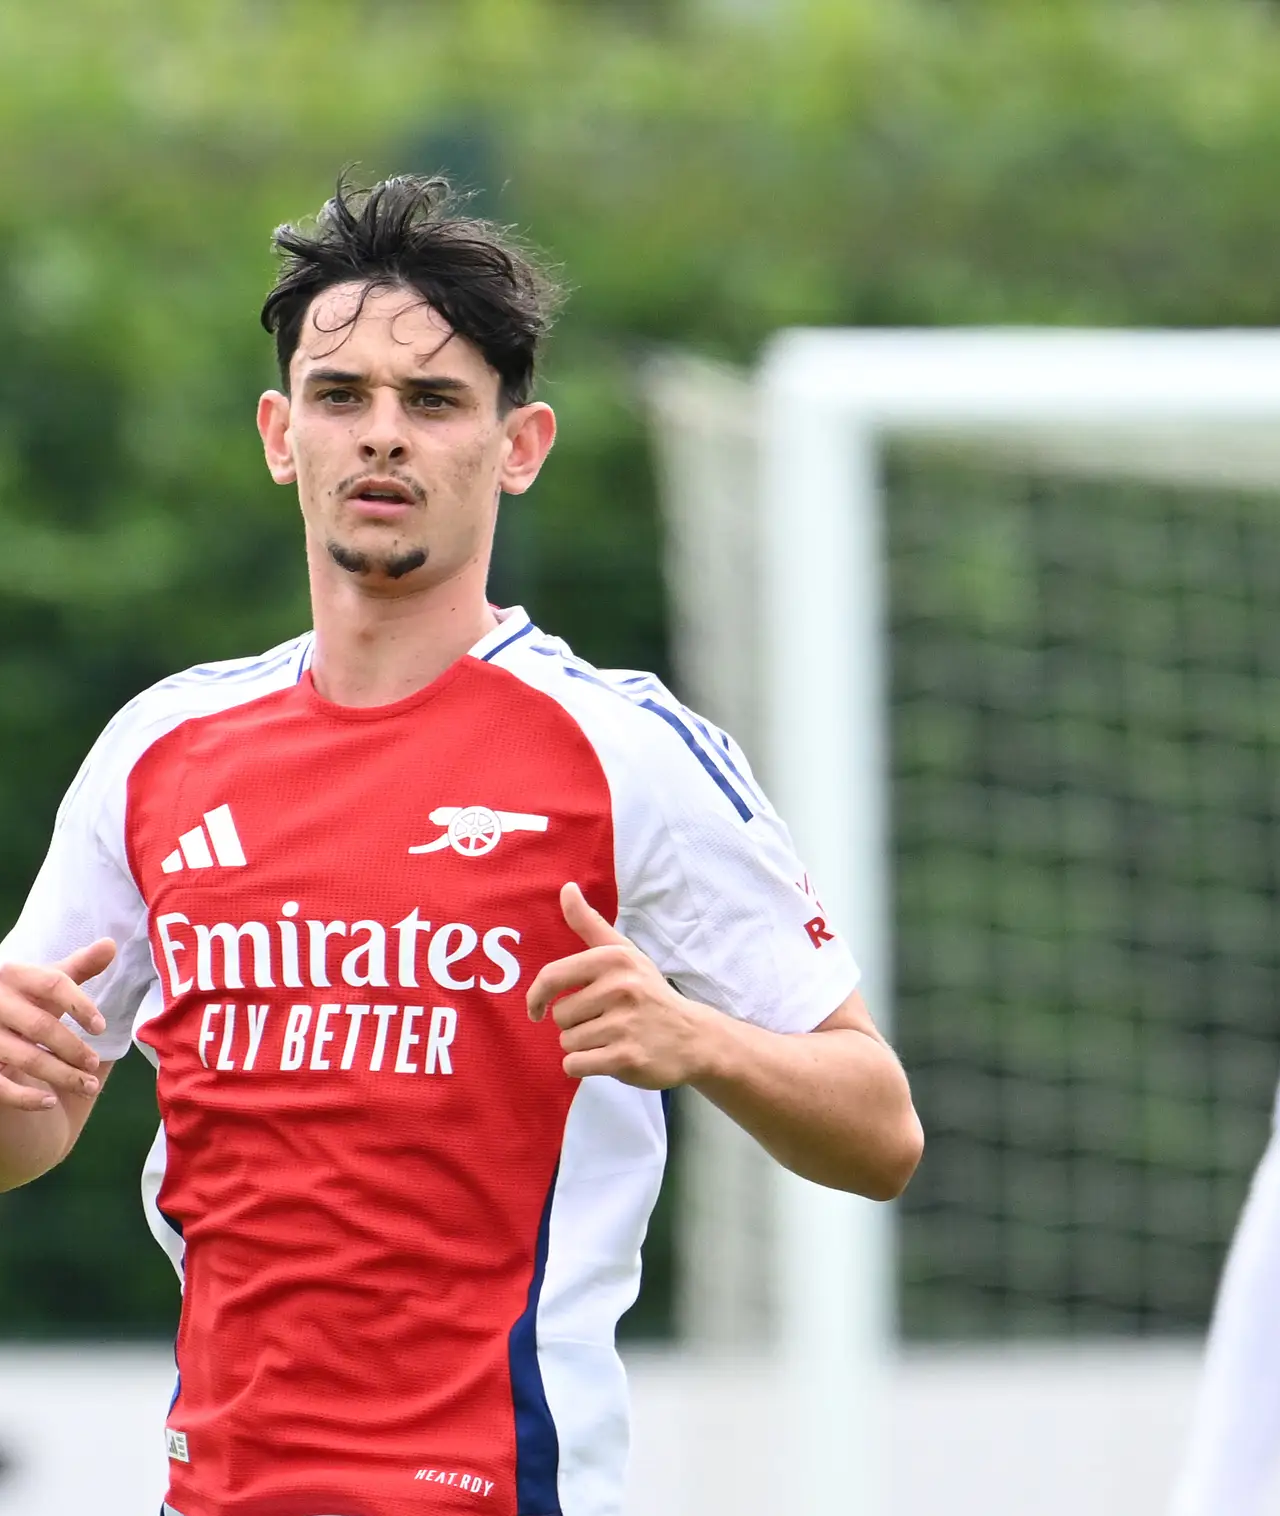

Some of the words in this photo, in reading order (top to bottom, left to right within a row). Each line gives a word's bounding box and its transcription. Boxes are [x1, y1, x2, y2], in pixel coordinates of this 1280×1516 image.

[156, 901, 521, 998] Emirates
[198, 1004, 269, 1071] FLY
[279, 1003, 458, 1076] BETTER
[414, 1469, 495, 1497] HEAT.RDY
